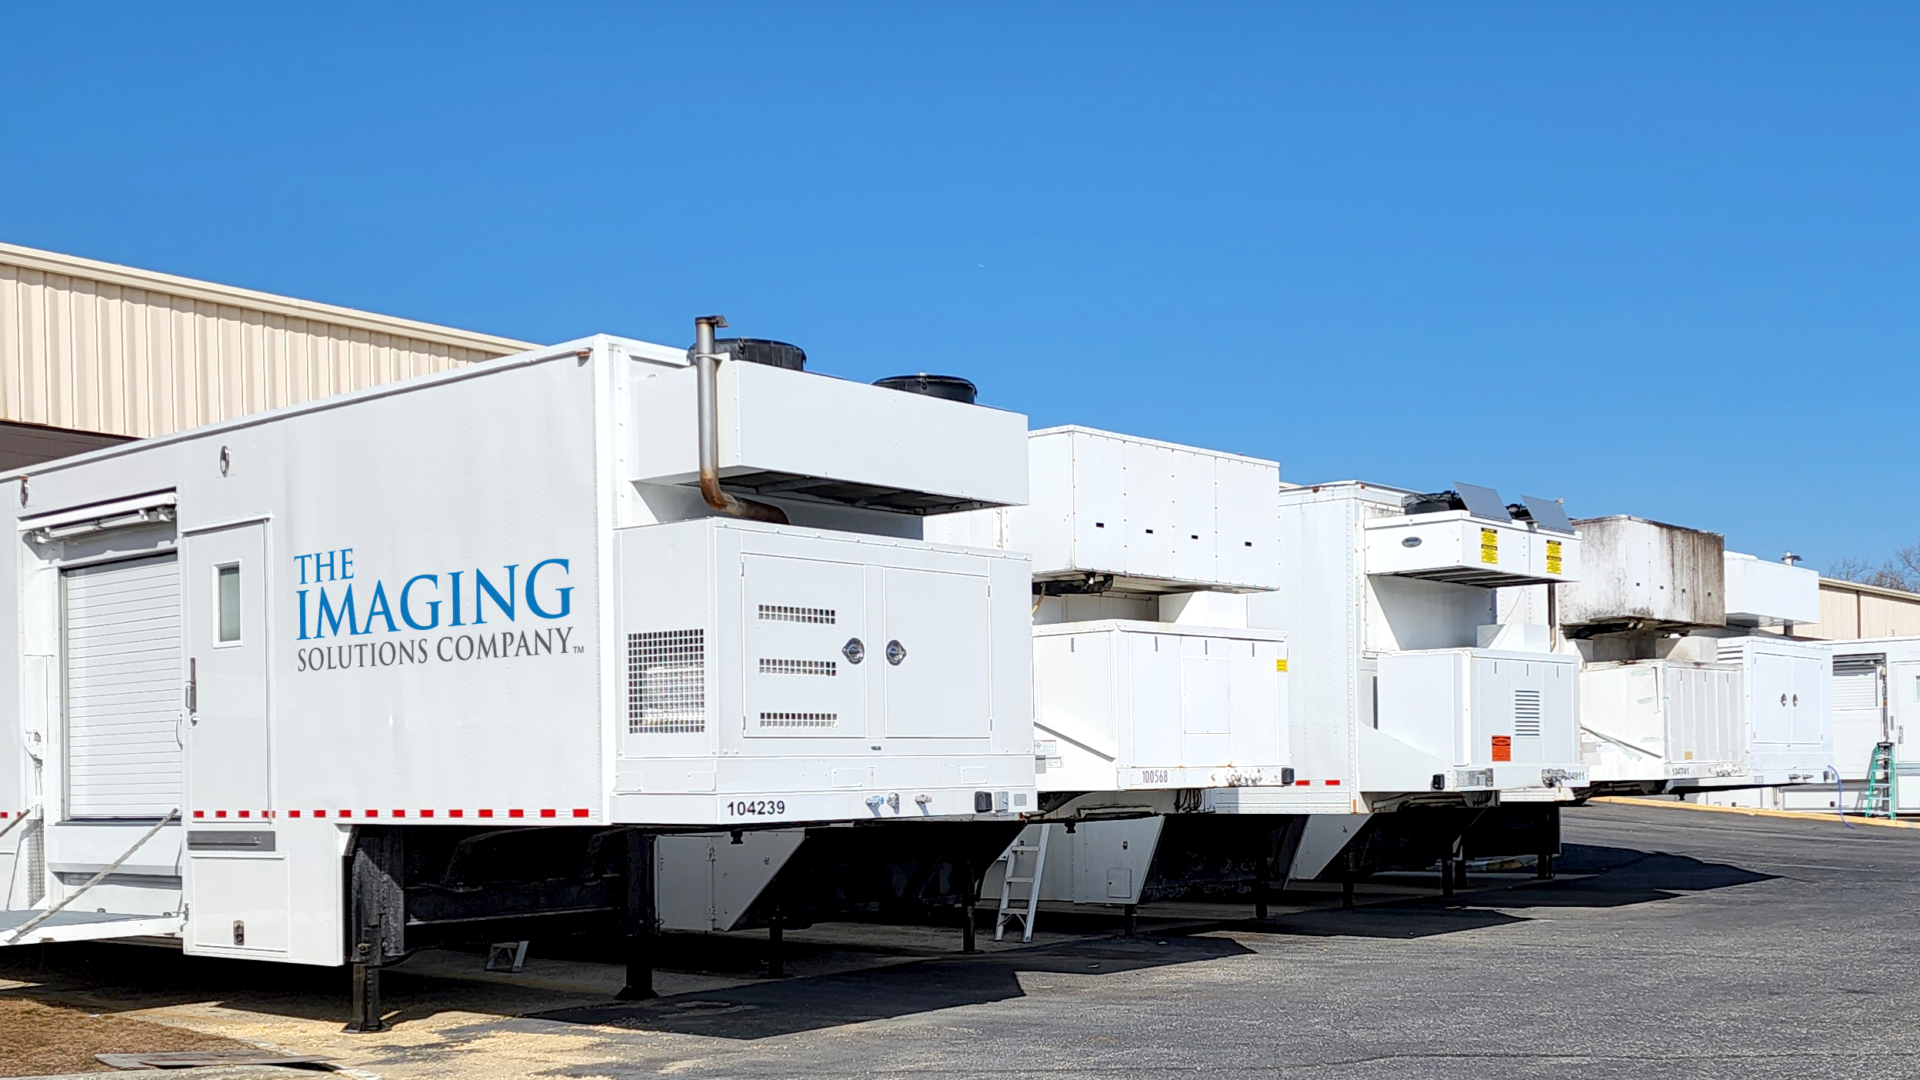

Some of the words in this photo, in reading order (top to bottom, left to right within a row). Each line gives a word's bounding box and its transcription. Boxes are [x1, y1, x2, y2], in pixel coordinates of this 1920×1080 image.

[294, 547, 355, 585] THE
[295, 558, 575, 641] IMAGING
[297, 638, 428, 672] SOLUTIONS
[436, 626, 574, 662] COMPANY
[1142, 769, 1169, 784] 100568
[727, 800, 785, 816] 104239
